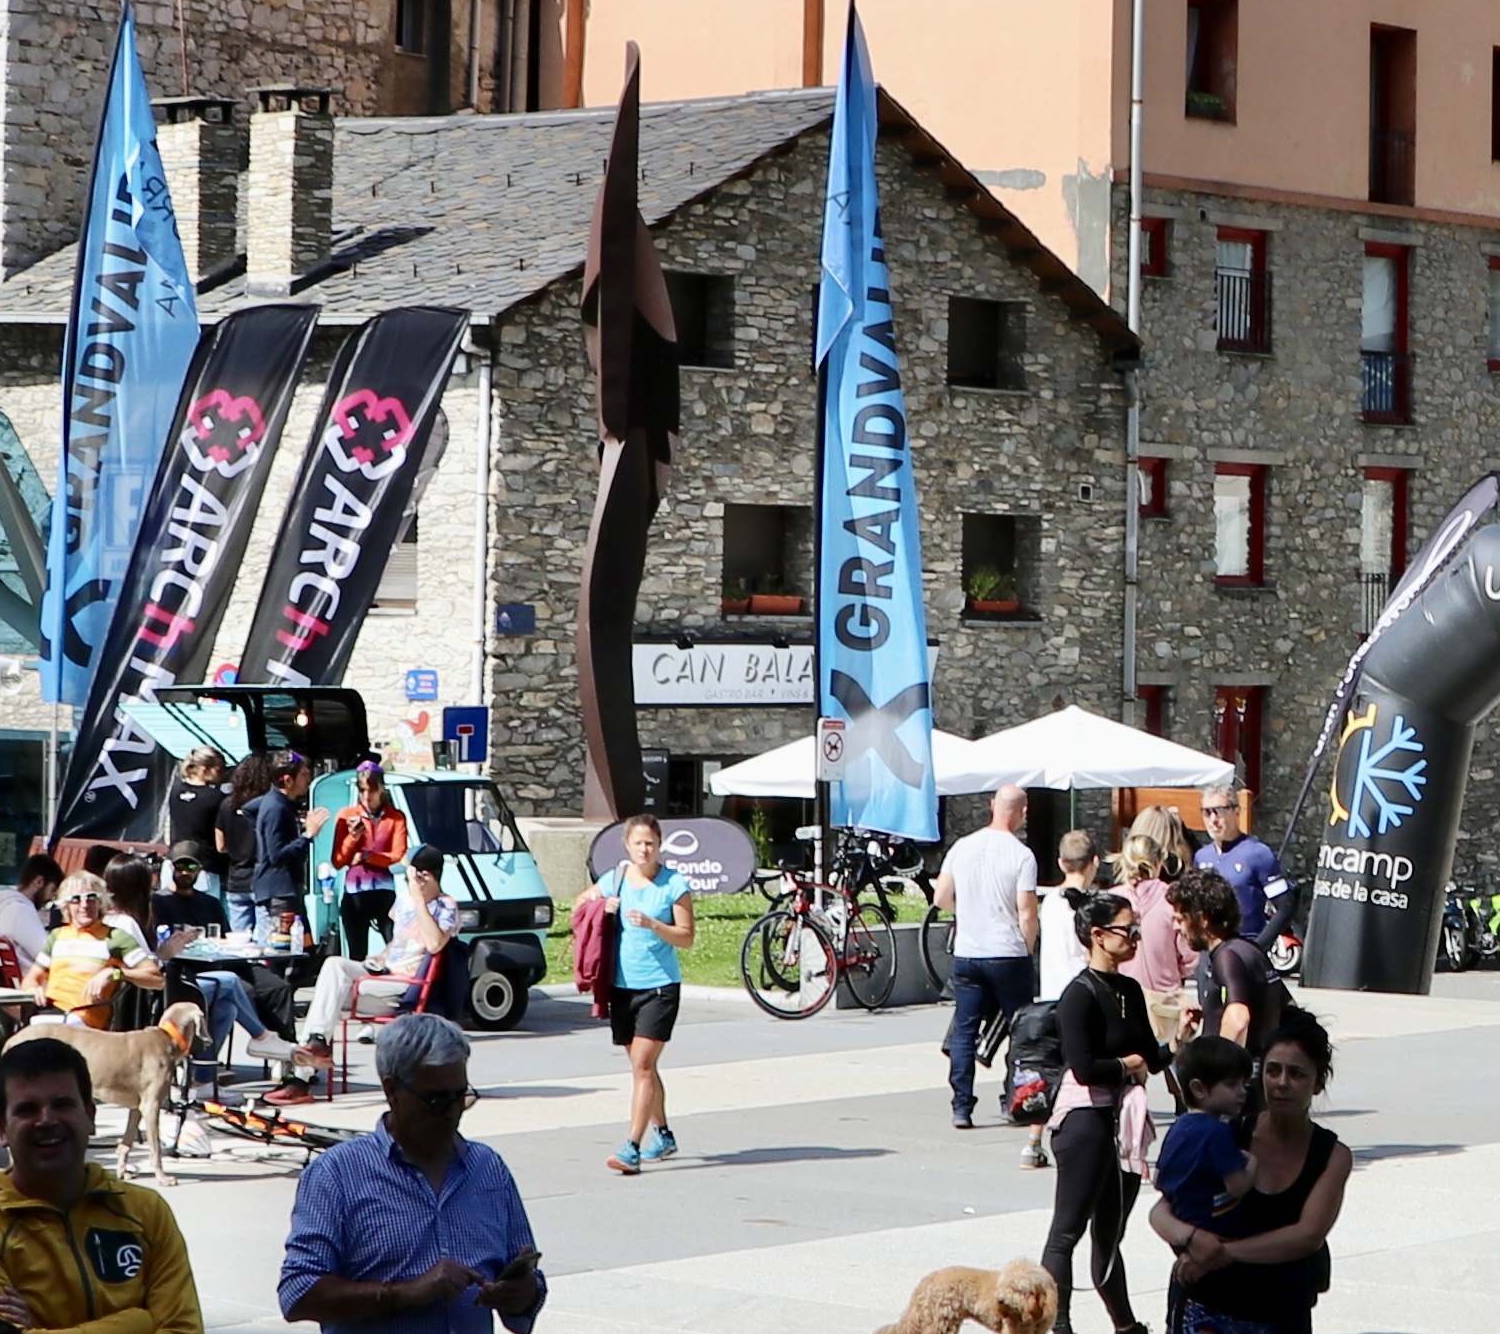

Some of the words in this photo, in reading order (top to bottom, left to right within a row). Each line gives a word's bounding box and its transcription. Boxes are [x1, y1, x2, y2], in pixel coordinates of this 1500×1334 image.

[651, 652, 726, 685] CAN
[704, 689, 742, 700] GASTRO
[744, 689, 764, 700] BAR
[1331, 877, 1352, 900] de
[1353, 879, 1368, 902] la
[1370, 889, 1409, 910] casa
